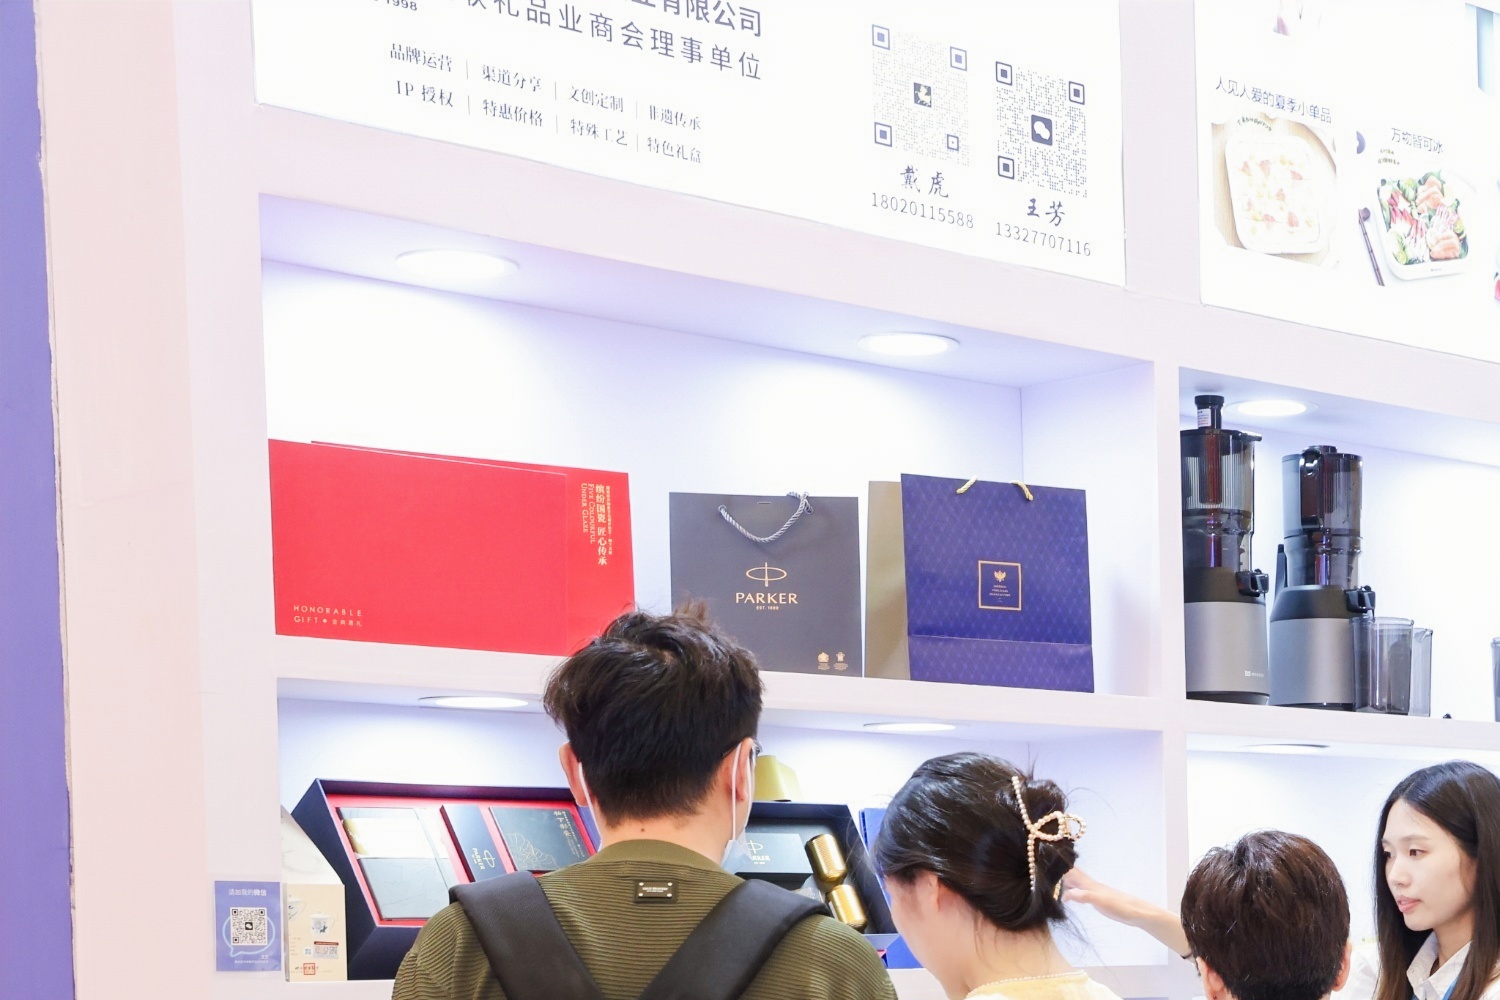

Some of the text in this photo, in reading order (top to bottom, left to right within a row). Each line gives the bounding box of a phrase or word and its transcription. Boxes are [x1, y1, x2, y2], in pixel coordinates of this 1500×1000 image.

[390, 43, 702, 130] 品牌运营 渠道分享 文创定制 非遗传承
[1216, 76, 1332, 124] 人见人爱的夏季小单品
[396, 80, 701, 163] IP 授权 特惠价格 特殊工艺 特色礼盒
[1390, 127, 1444, 154] 万物皆可冰
[872, 192, 974, 229] 18020115588
[996, 222, 1091, 257] 13327707116
[597, 527, 607, 566] 匠心传承
[293, 605, 362, 617] HONORABLE
[735, 592, 798, 604] PARKER
[294, 615, 318, 624] GIFT
[228, 888, 267, 897] 请加我的微信
